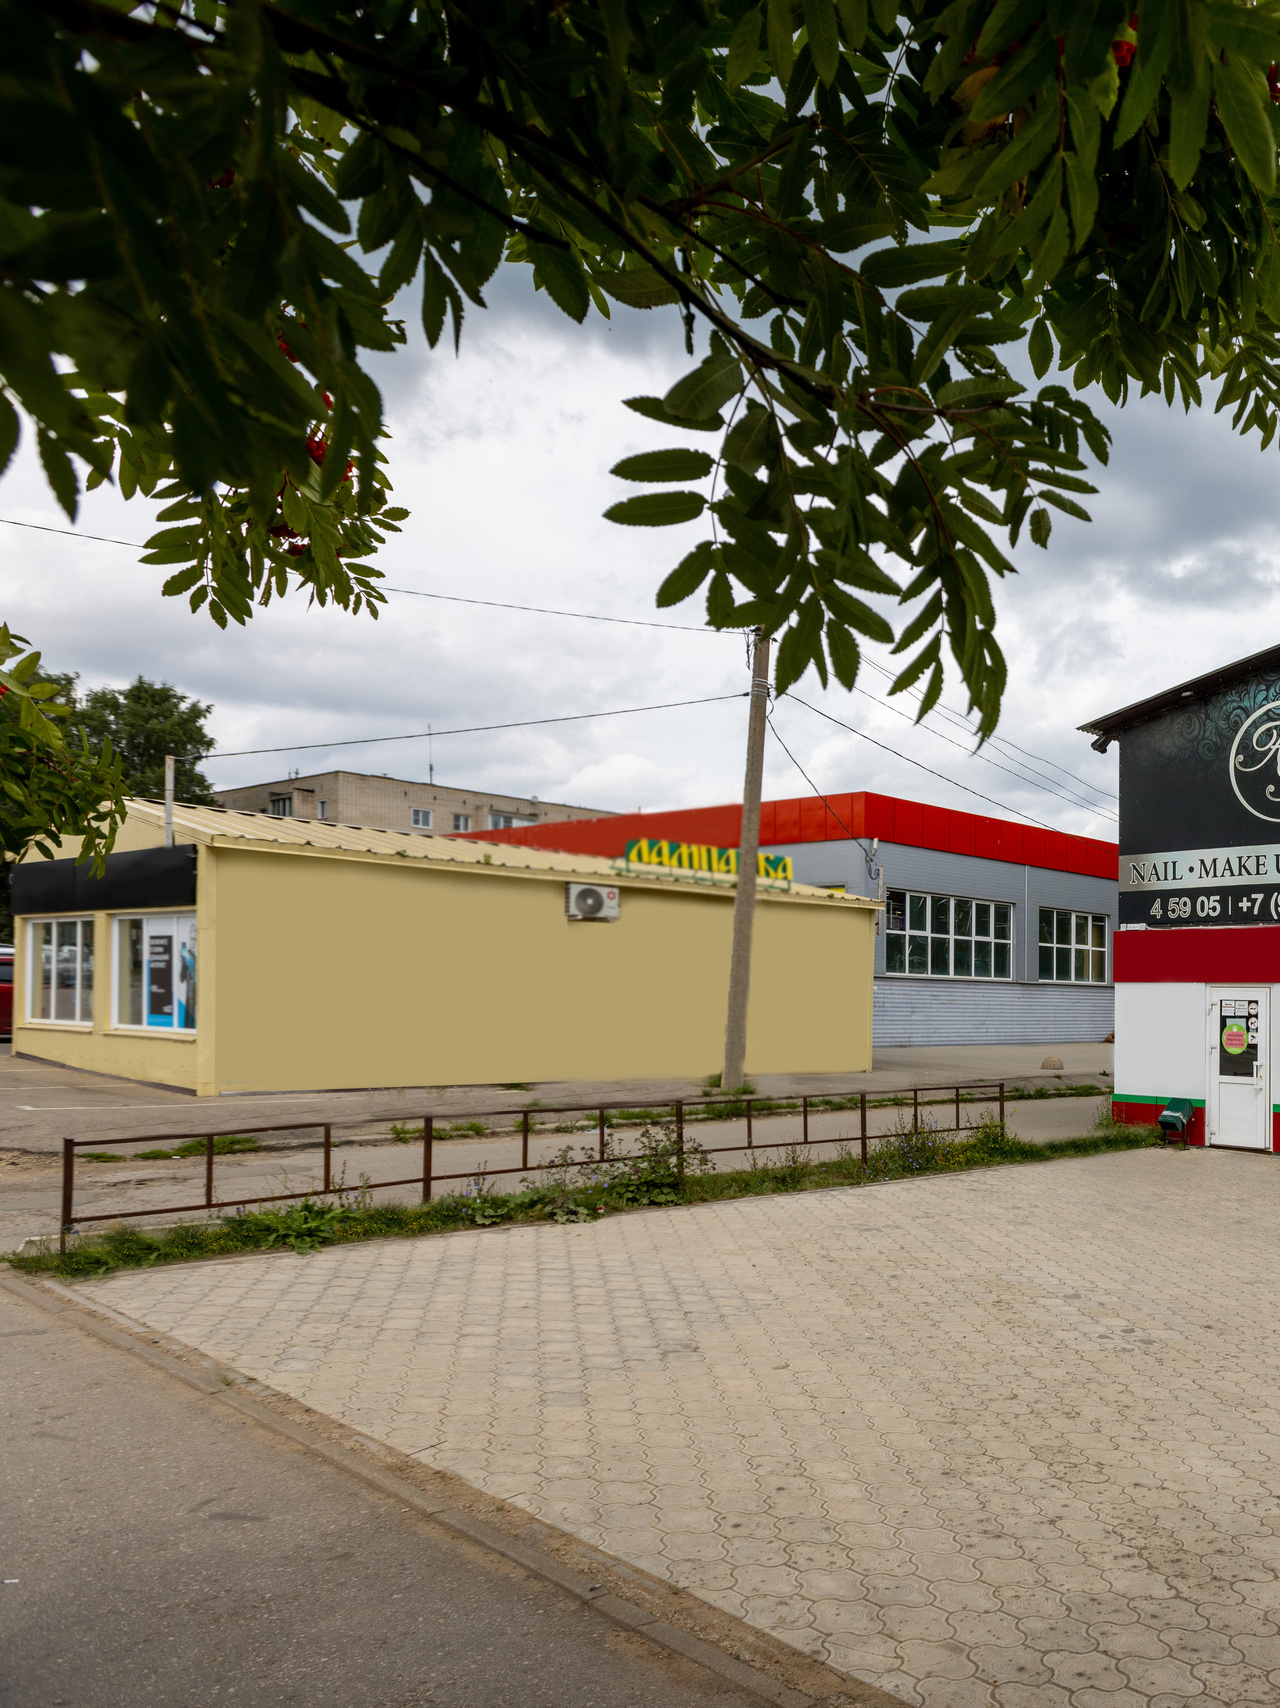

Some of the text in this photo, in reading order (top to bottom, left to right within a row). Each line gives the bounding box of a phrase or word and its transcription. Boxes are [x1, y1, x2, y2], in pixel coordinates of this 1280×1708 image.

[628, 837, 794, 881] ЛАМПАКА
[1129, 861, 1184, 885] NAIL
[1197, 853, 1268, 879] MAKE
[1150, 898, 1163, 919] 4
[1167, 897, 1192, 918] 59
[1196, 895, 1221, 917] 05
[1238, 893, 1265, 915] +7
